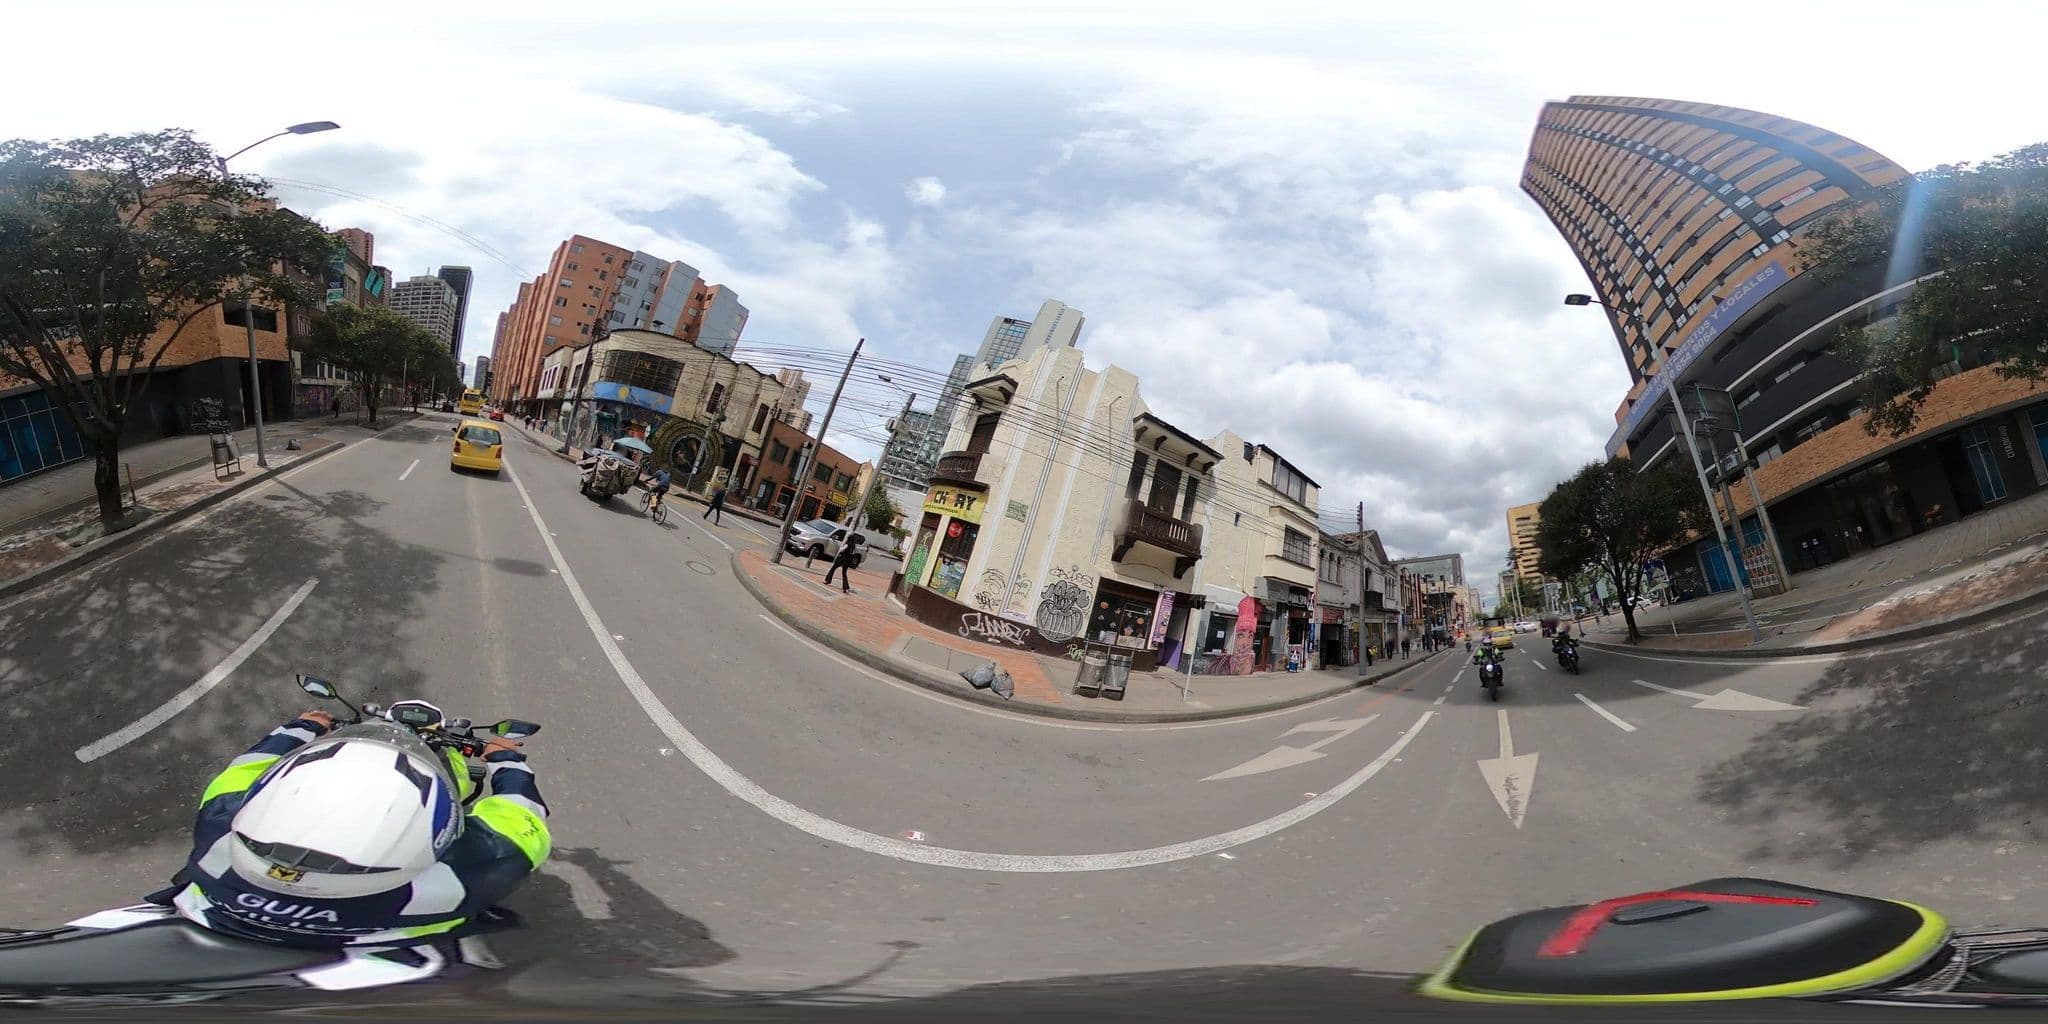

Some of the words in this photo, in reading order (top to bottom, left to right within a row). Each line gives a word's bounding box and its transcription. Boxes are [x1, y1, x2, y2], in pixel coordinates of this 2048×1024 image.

[1711, 311, 1720, 320] Y
[1720, 266, 1776, 313] LOCALES
[237, 893, 338, 922] GUIA
